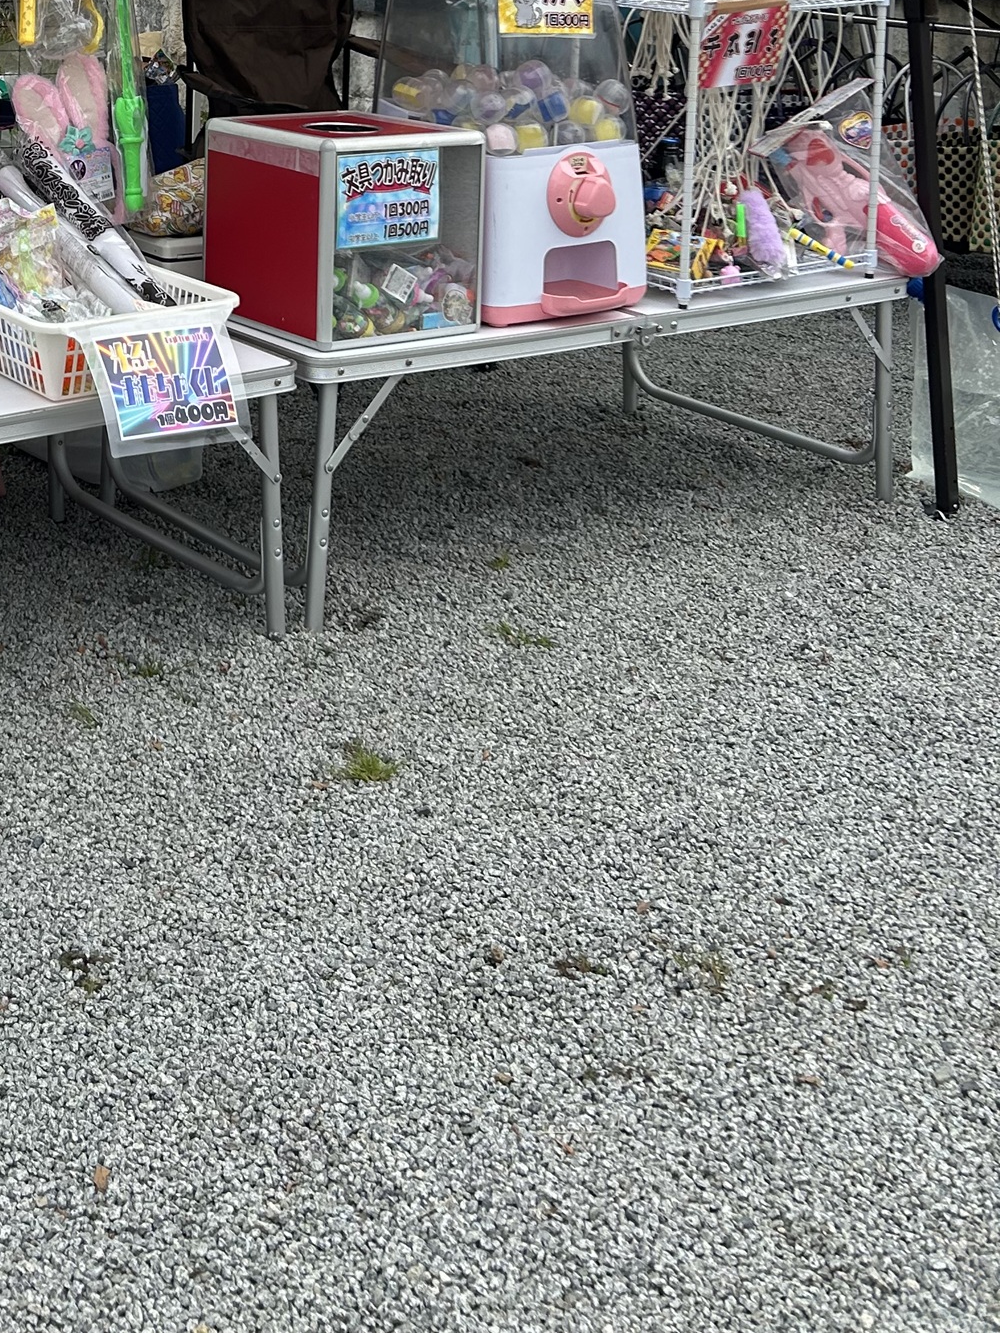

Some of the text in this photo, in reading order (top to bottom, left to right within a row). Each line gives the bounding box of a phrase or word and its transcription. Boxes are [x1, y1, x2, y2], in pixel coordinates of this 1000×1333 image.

[544, 13, 590, 28] 1回300円
[341, 157, 437, 196] 文具つかみ取り
[384, 199, 430, 218] 1回300円
[383, 220, 430, 239] 1回500円
[157, 400, 230, 427] 1個400円
